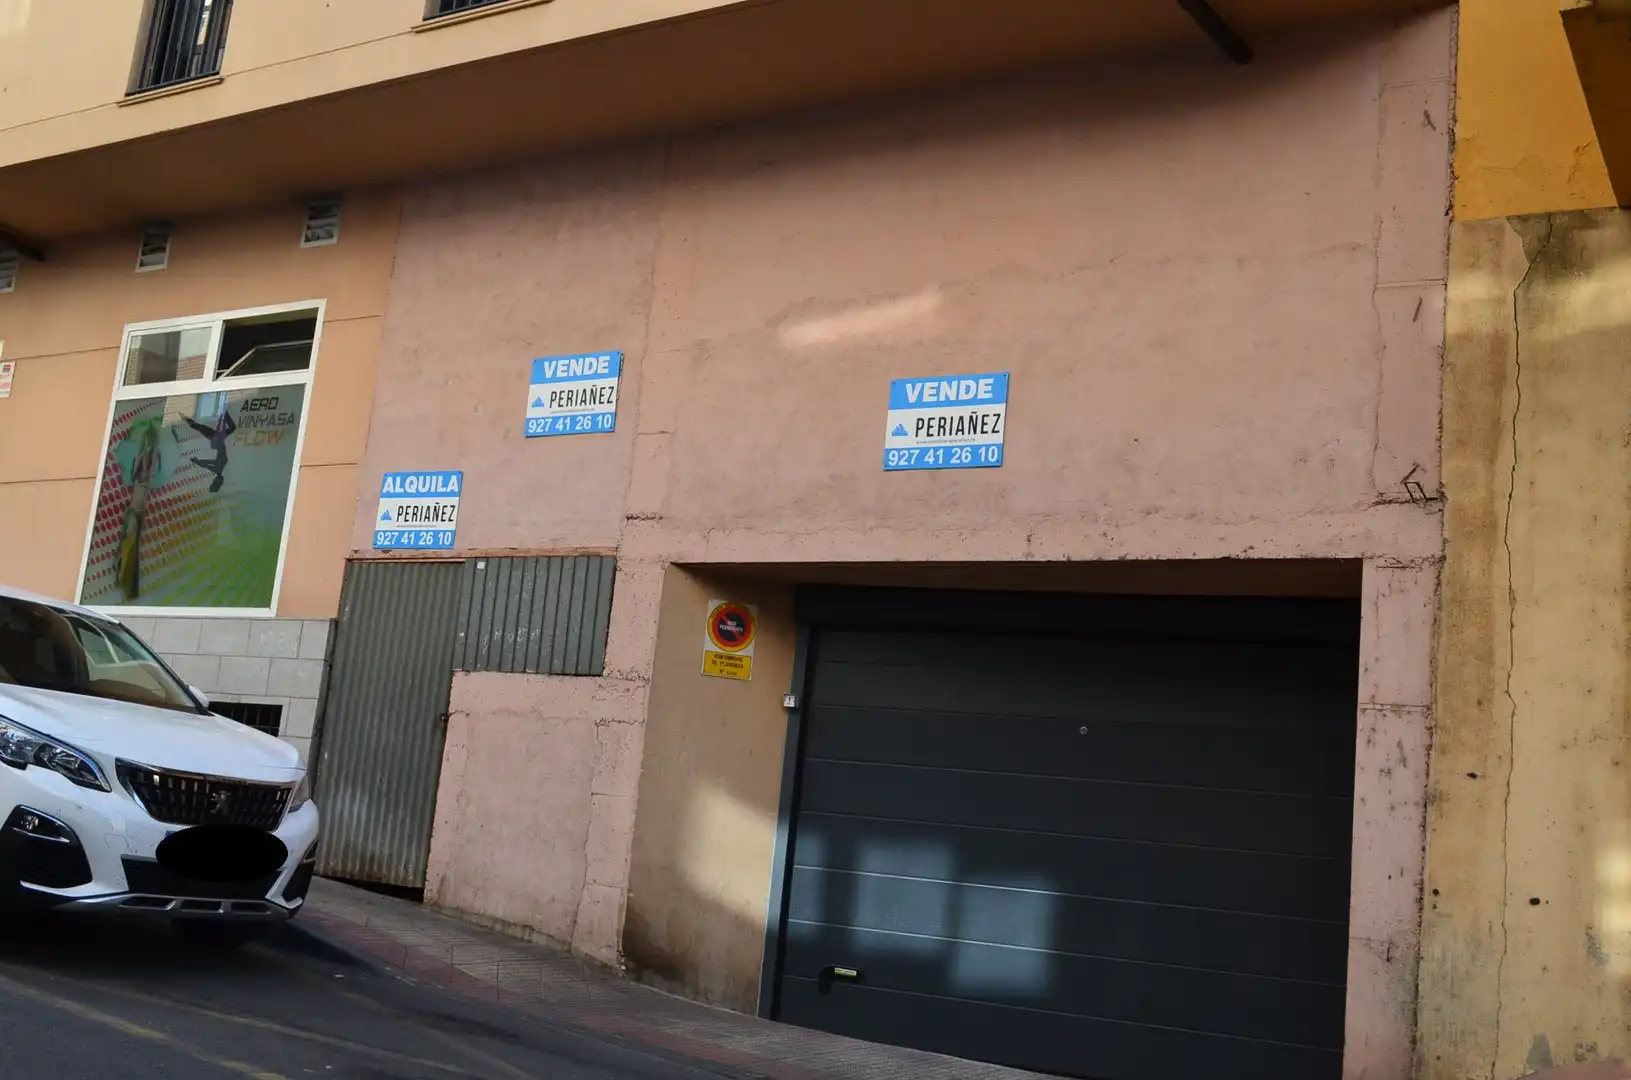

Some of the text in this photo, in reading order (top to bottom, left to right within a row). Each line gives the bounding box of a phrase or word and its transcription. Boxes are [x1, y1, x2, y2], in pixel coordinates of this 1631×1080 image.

[543, 356, 611, 379] VENDE
[549, 384, 615, 409] PERIAÑEZ
[905, 378, 994, 404] VENDE
[240, 396, 279, 413] AERO
[238, 412, 295, 429] VINYASA
[528, 414, 612, 433] 927 41 26 10
[915, 411, 1002, 438] PERIAÑEZ
[235, 428, 285, 447] FLOW
[888, 445, 998, 466] 927 41 26 10
[382, 475, 459, 494] ALQUILA
[396, 501, 456, 523] PERIAÑEZ
[376, 531, 452, 545] 927 41 26 10
